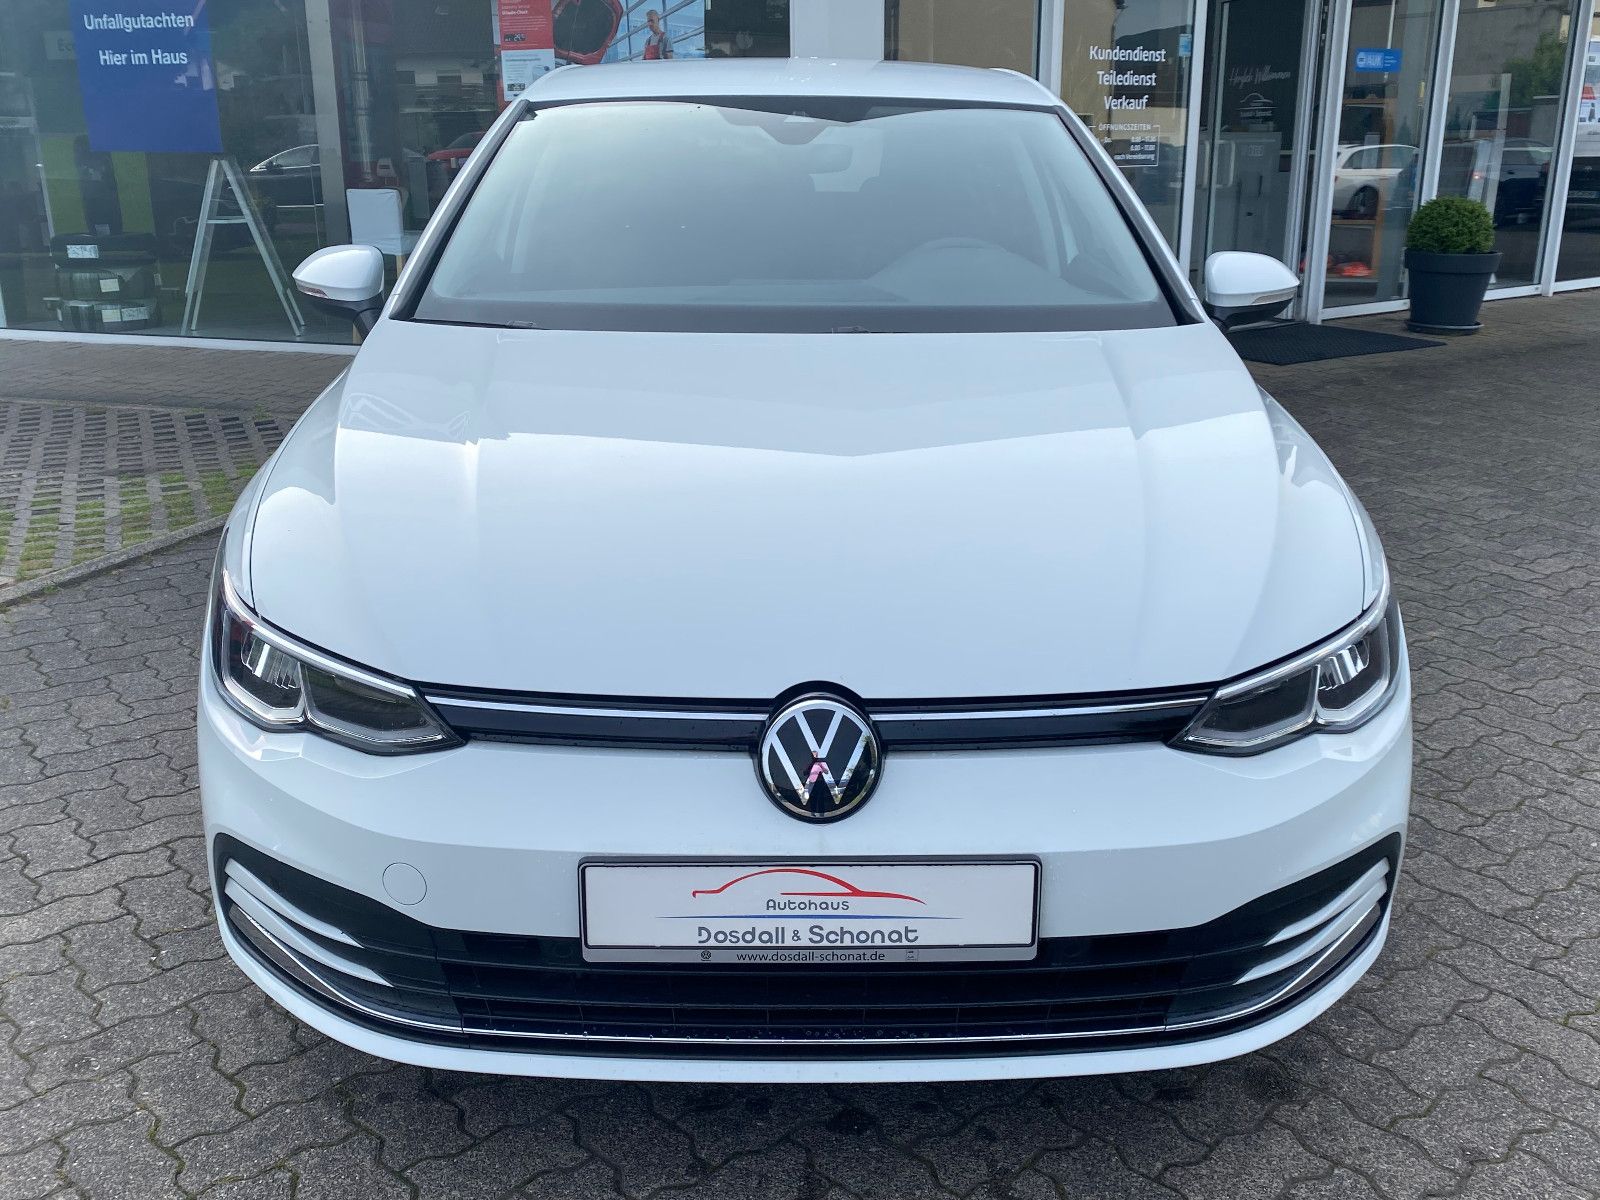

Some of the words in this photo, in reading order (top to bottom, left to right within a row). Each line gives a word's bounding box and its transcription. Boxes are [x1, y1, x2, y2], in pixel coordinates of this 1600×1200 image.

[83, 12, 195, 33] Unfallgutachten
[98, 49, 127, 66] Hier
[130, 49, 149, 65] im
[151, 48, 188, 64] Haus
[1088, 45, 1167, 62] Kundendienst
[1096, 69, 1157, 87] Teiledienst
[1103, 94, 1150, 110] Verkauf
[1098, 122, 1152, 131] ÖFFNUNGSZEITEN
[766, 898, 850, 912] Autohaus
[697, 926, 786, 944] Dosdall
[791, 929, 802, 942] &
[808, 924, 919, 944] Schonat
[736, 950, 886, 963] www.dosdall-schonat.de
